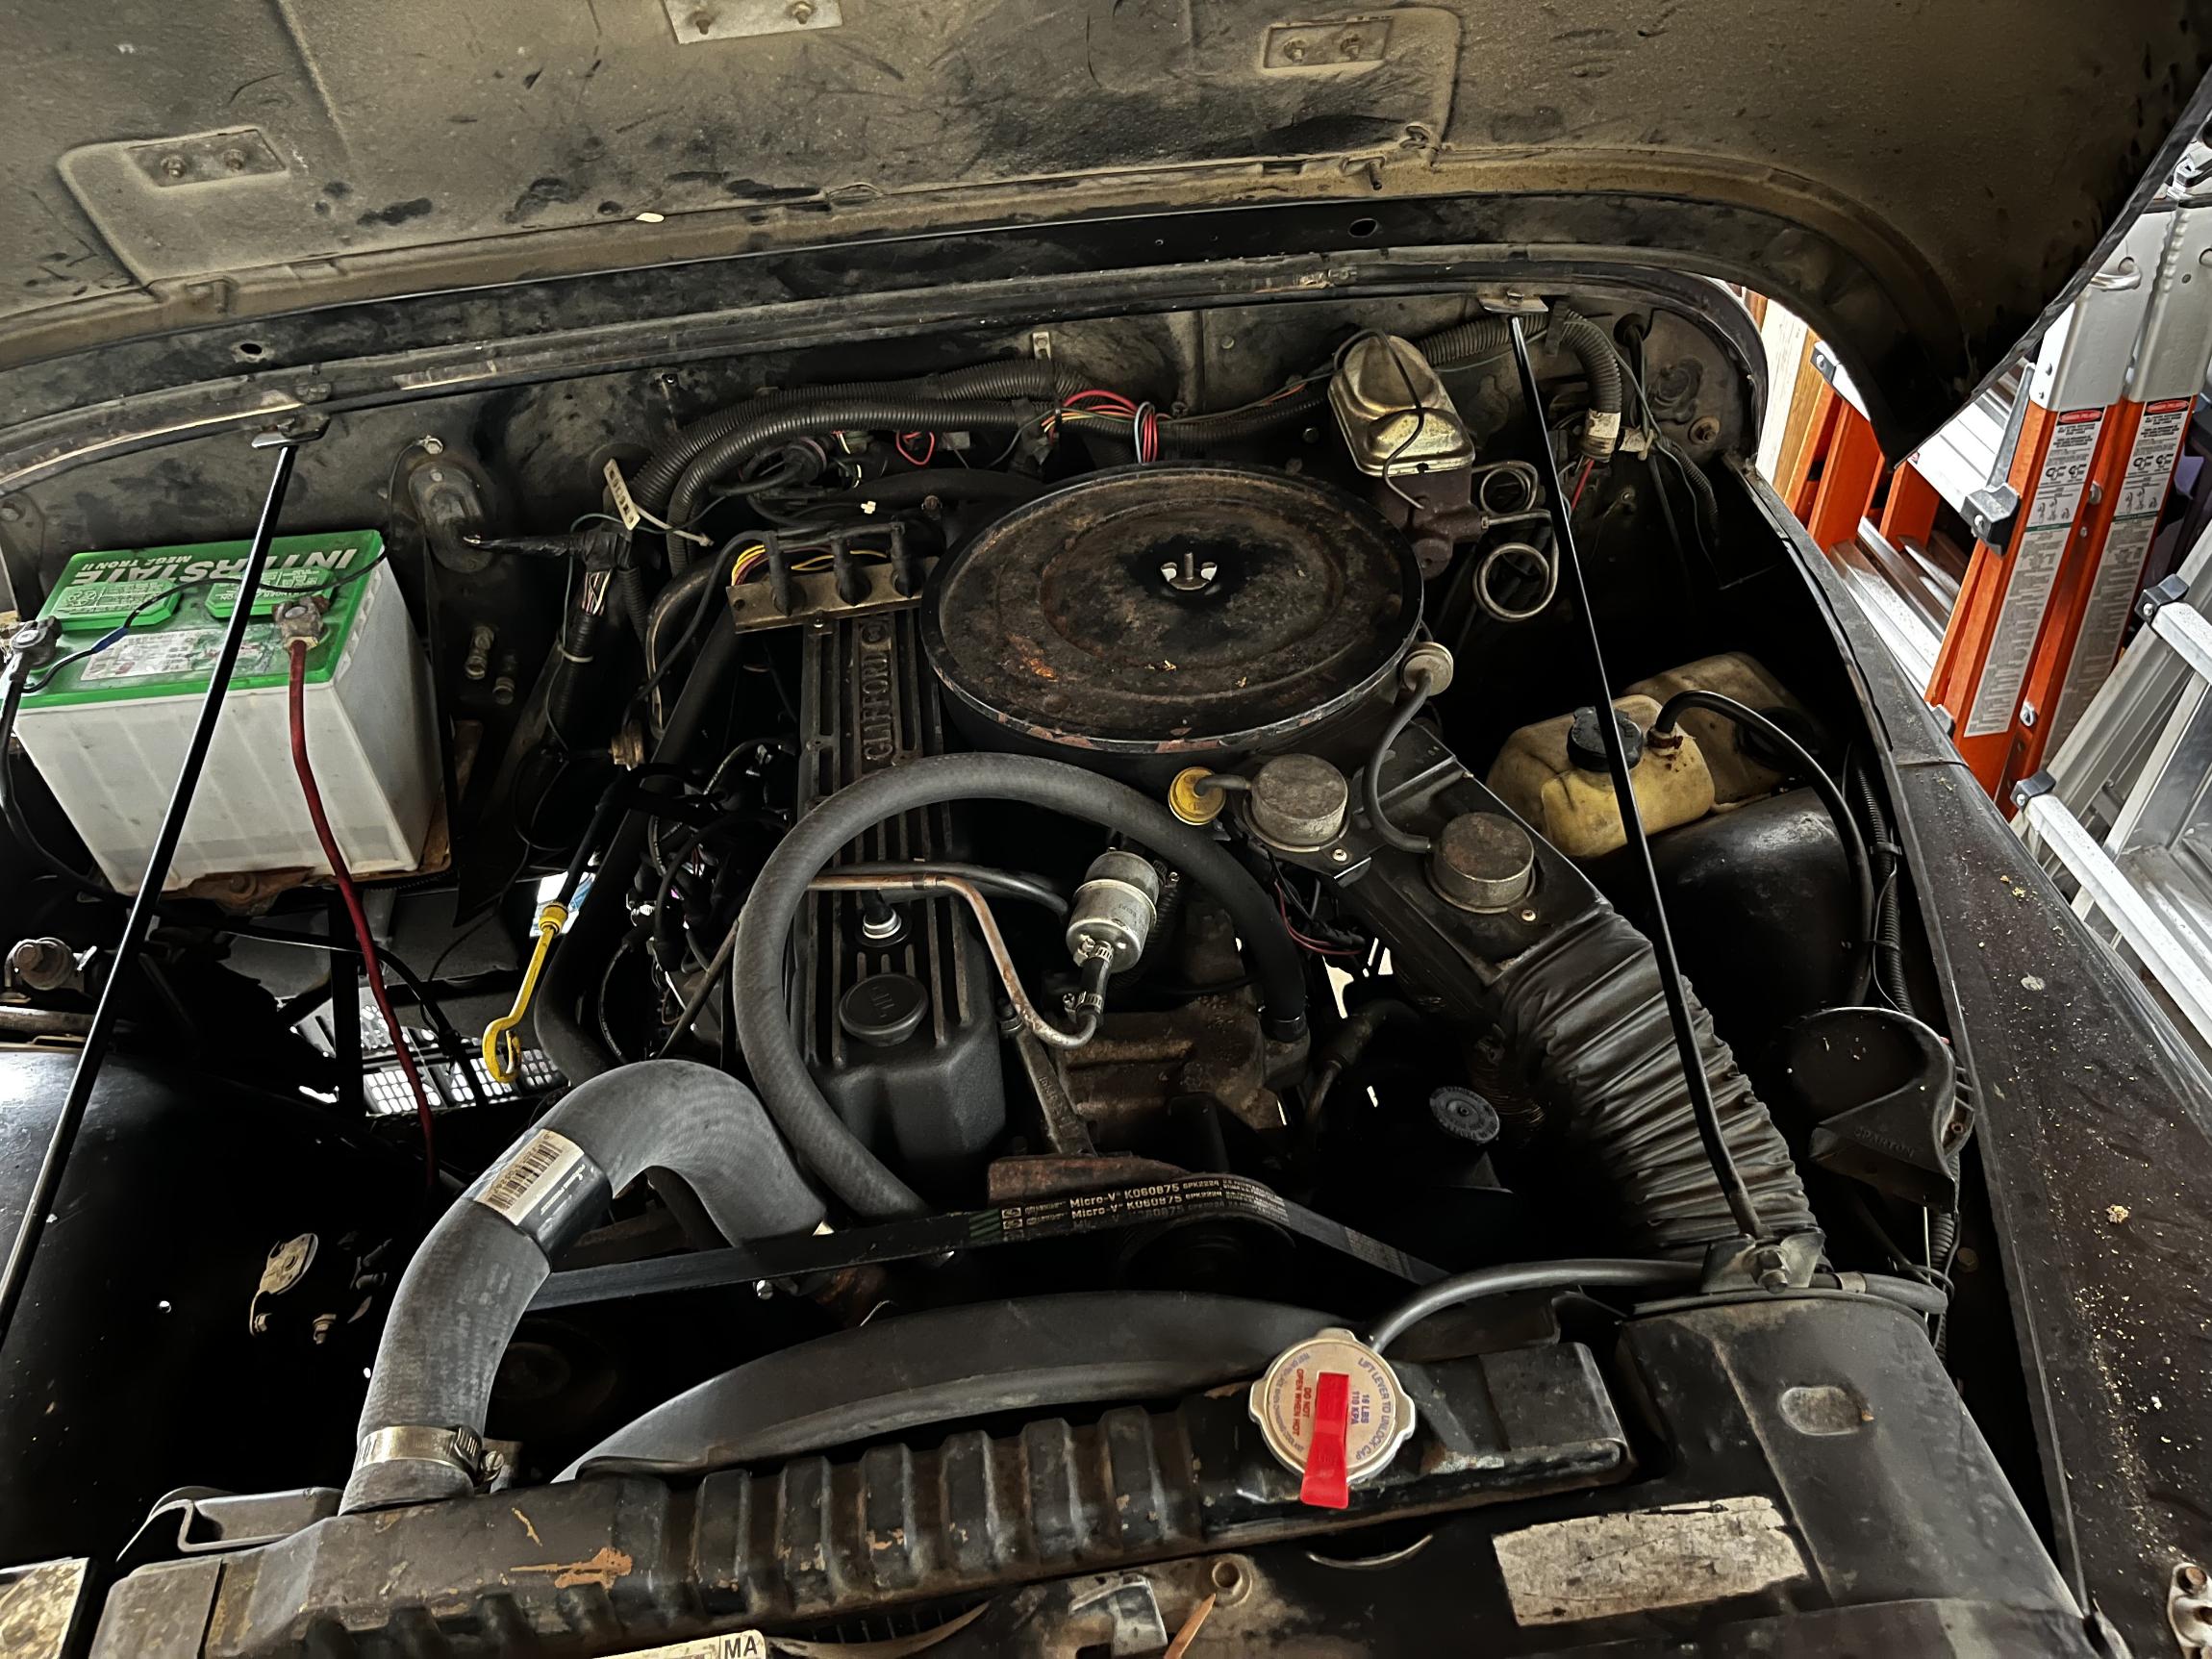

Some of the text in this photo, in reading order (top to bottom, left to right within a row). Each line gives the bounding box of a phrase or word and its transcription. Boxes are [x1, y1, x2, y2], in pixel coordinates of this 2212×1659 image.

[96, 560, 138, 569] TRON
[862, 653, 893, 759] CLIFFORD
[1123, 1182, 1180, 1199] K060875
[1126, 1194, 1183, 1210] K060875
[1303, 1387, 1311, 1399] DO
[1351, 1407, 1360, 1425] KPA
[1355, 1358, 1391, 1461] LIFT LEVER TO UNLOCK CAP
[1361, 1406, 1370, 1423] LBS
[725, 1636, 757, 1659] MA
